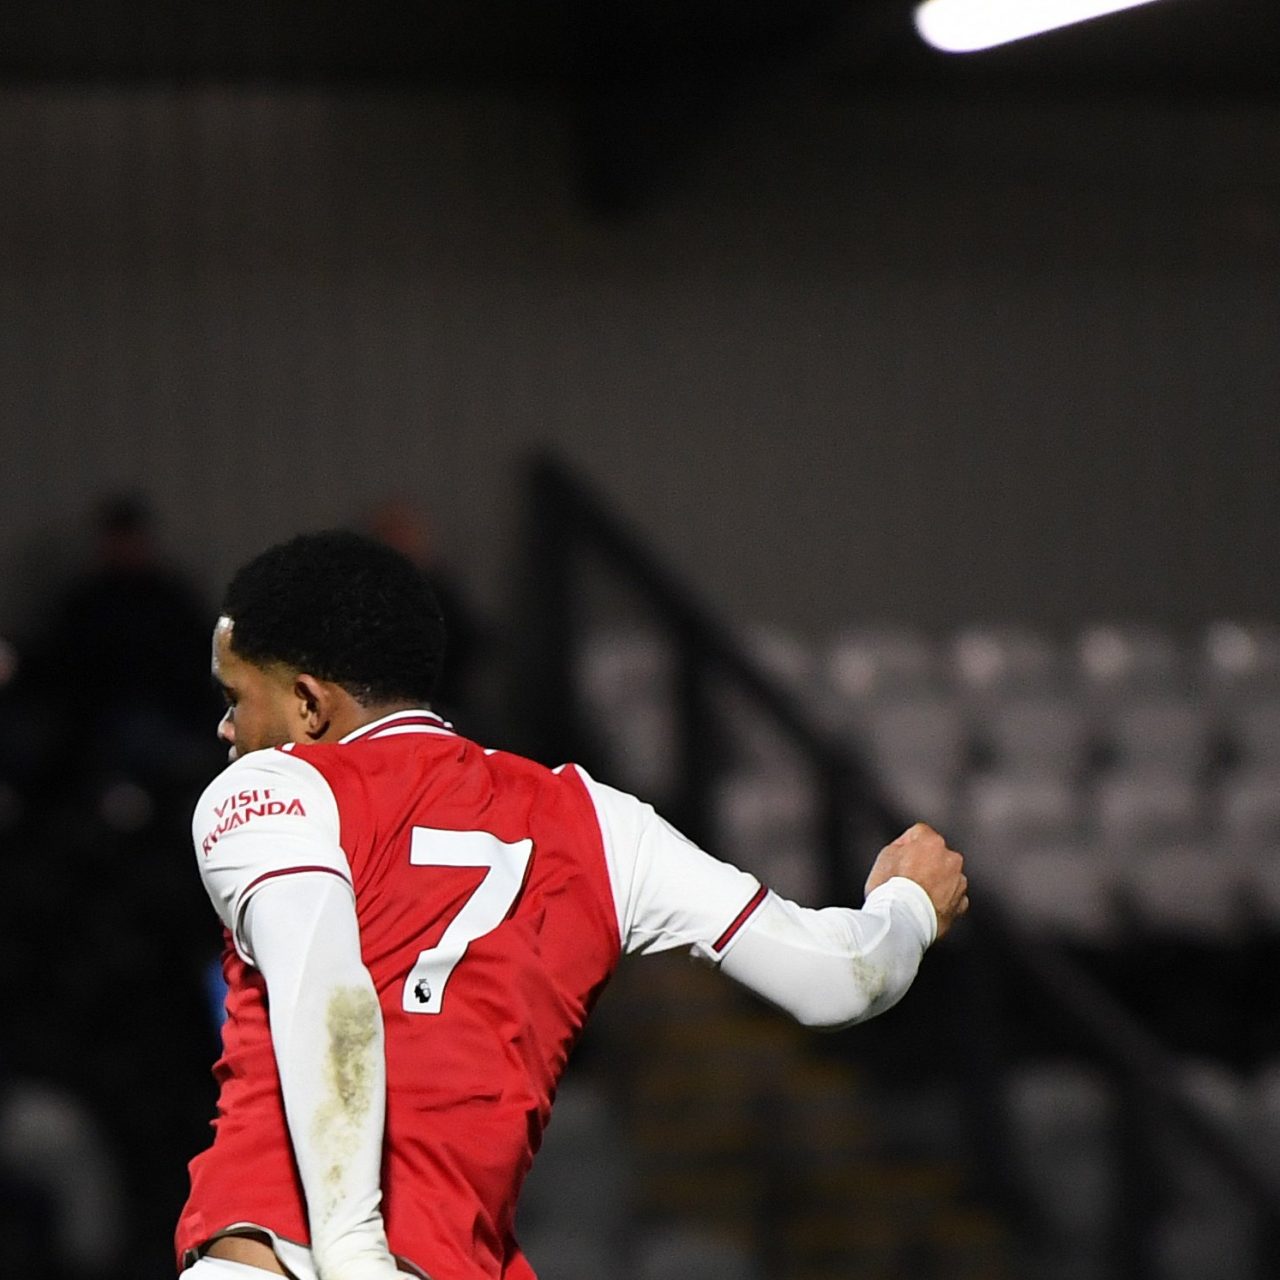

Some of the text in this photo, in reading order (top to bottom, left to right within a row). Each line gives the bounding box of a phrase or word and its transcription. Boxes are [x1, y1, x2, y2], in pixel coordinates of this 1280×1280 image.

[202, 798, 307, 858] RWANDA
[214, 788, 274, 818] VISIT
[402, 826, 534, 1014] 7
